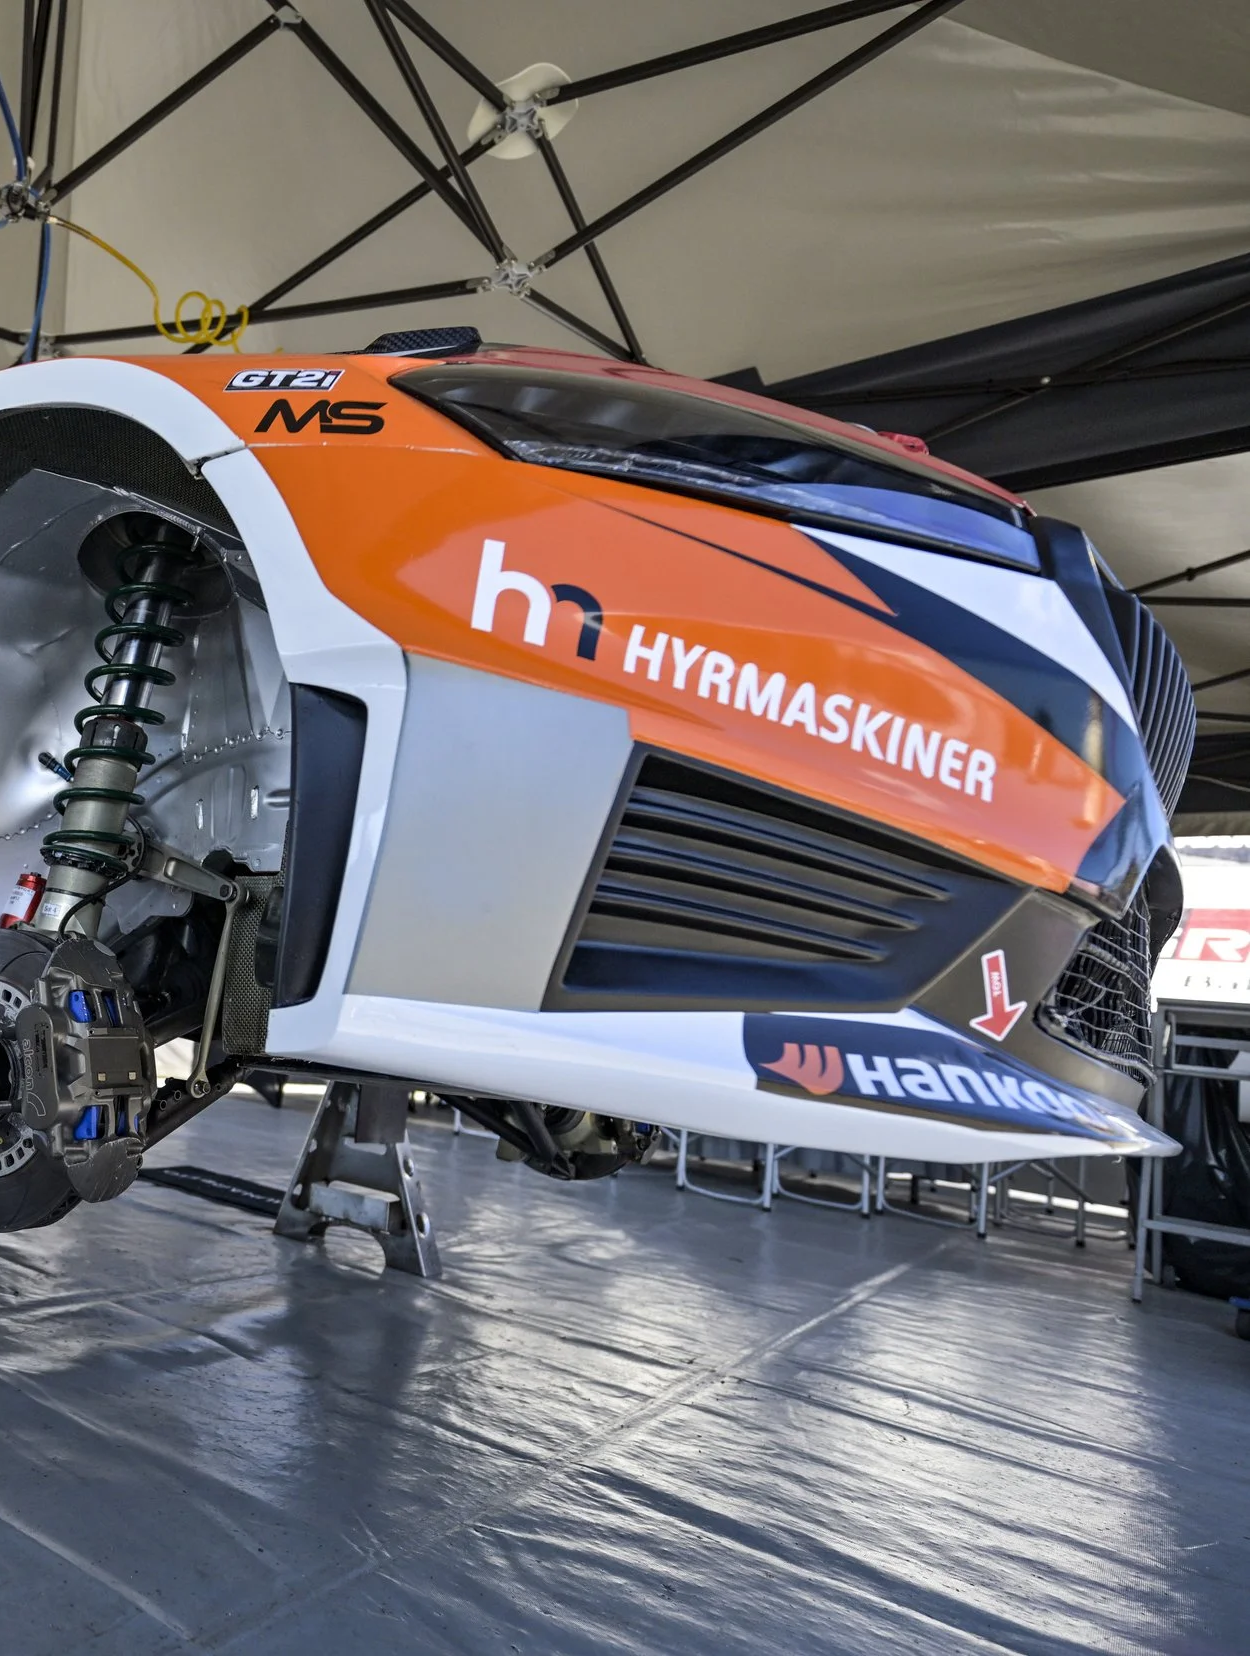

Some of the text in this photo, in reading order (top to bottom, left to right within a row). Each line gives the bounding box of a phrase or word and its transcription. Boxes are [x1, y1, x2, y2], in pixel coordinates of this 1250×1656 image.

[232, 370, 337, 389] GT2i
[253, 398, 389, 435] MS
[622, 624, 997, 802] HYRMASKINER
[22, 1038, 35, 1091] alcon
